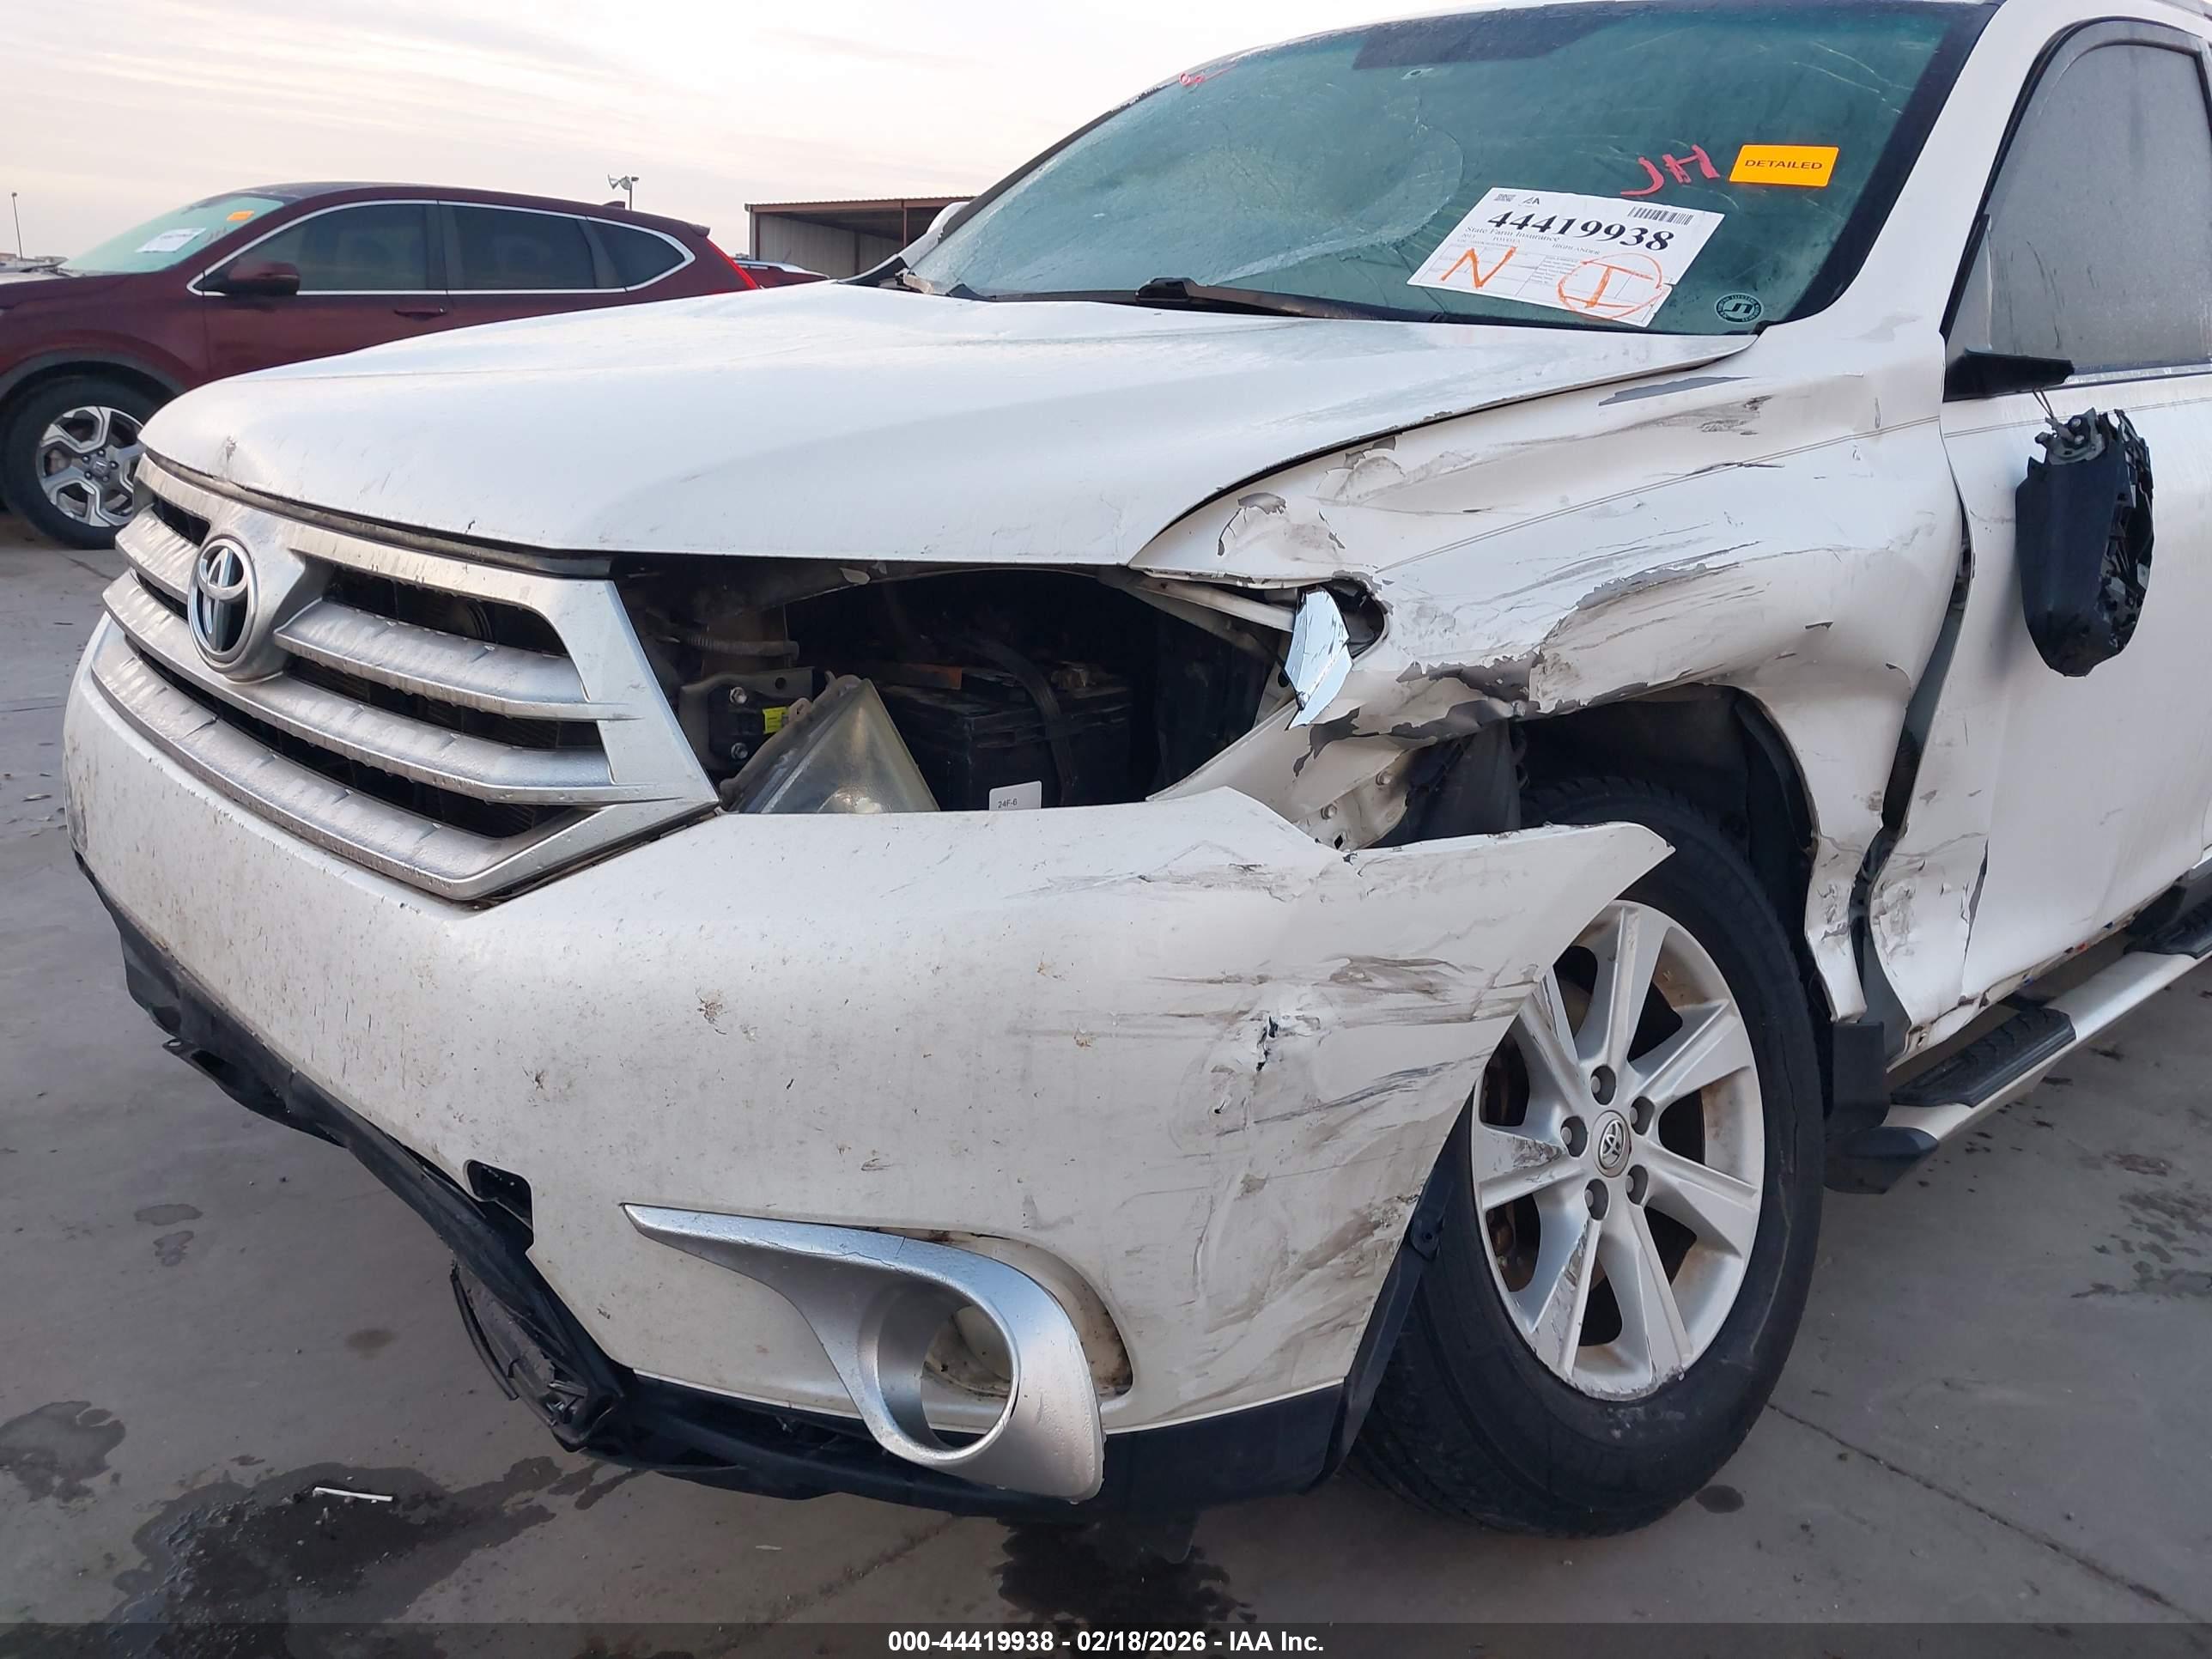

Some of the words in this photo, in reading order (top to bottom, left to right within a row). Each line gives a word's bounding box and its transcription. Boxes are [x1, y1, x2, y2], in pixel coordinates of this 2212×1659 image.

[1745, 159, 1822, 170] DETAILED
[1465, 226, 1488, 234] State
[1491, 228, 1513, 237] Farm
[1516, 231, 1560, 242] Insurance
[1487, 210, 1674, 251] 44419938
[1440, 246, 1517, 289] N
